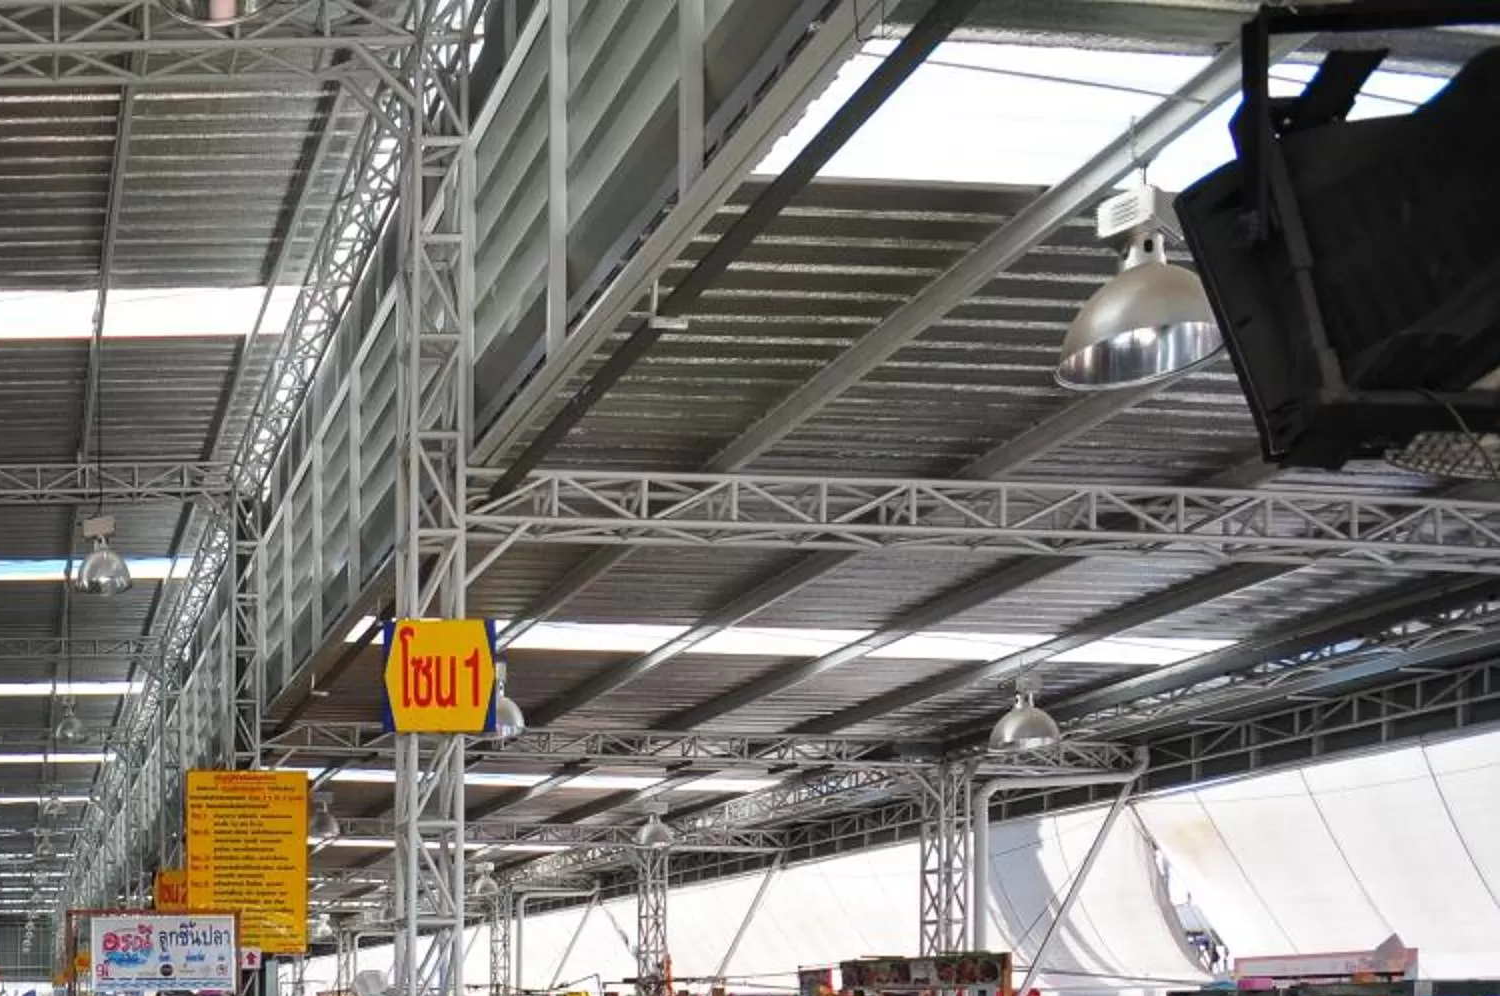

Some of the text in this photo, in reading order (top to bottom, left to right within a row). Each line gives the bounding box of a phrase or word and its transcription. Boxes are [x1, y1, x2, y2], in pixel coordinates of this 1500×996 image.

[400, 626, 480, 708] โซน 1
[159, 921, 231, 952] ลูกชิ้นปลา
